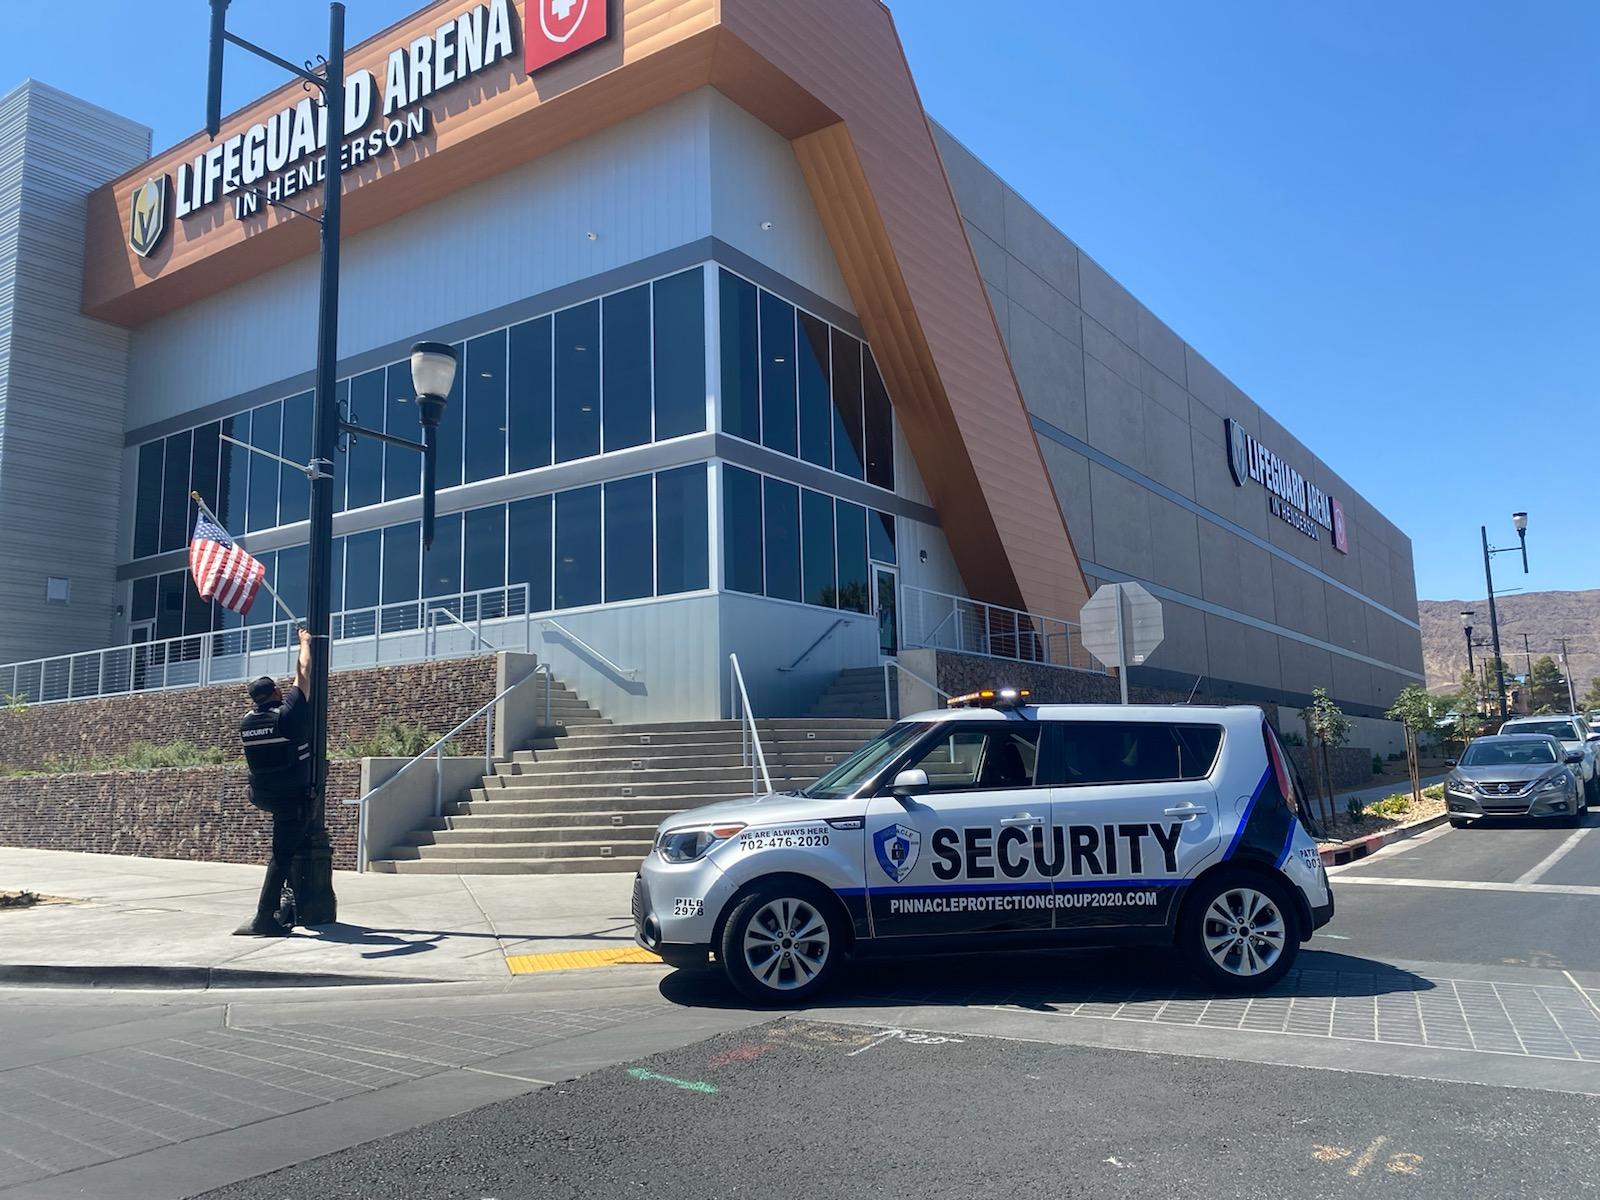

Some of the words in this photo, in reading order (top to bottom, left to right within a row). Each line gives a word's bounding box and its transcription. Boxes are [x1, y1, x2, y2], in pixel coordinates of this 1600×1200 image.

[383, 0, 513, 116] ARENA
[235, 188, 258, 220] IN
[1246, 434, 1306, 513] LIFEGUARD
[1306, 480, 1333, 532] ARENA
[1270, 496, 1281, 517] IN
[1281, 503, 1320, 541] HENDERSON
[242, 727, 274, 738] SECURITY
[773, 828, 805, 837] ALWAYS
[807, 827, 829, 835] HERE
[740, 835, 829, 852] 702-476-2020
[931, 823, 1183, 881] SECURITY
[674, 907, 704, 917] 2978
[676, 898, 703, 907] PILB
[890, 892, 1157, 913] PINNACLEPROTECTIONGROUP2020.COM
